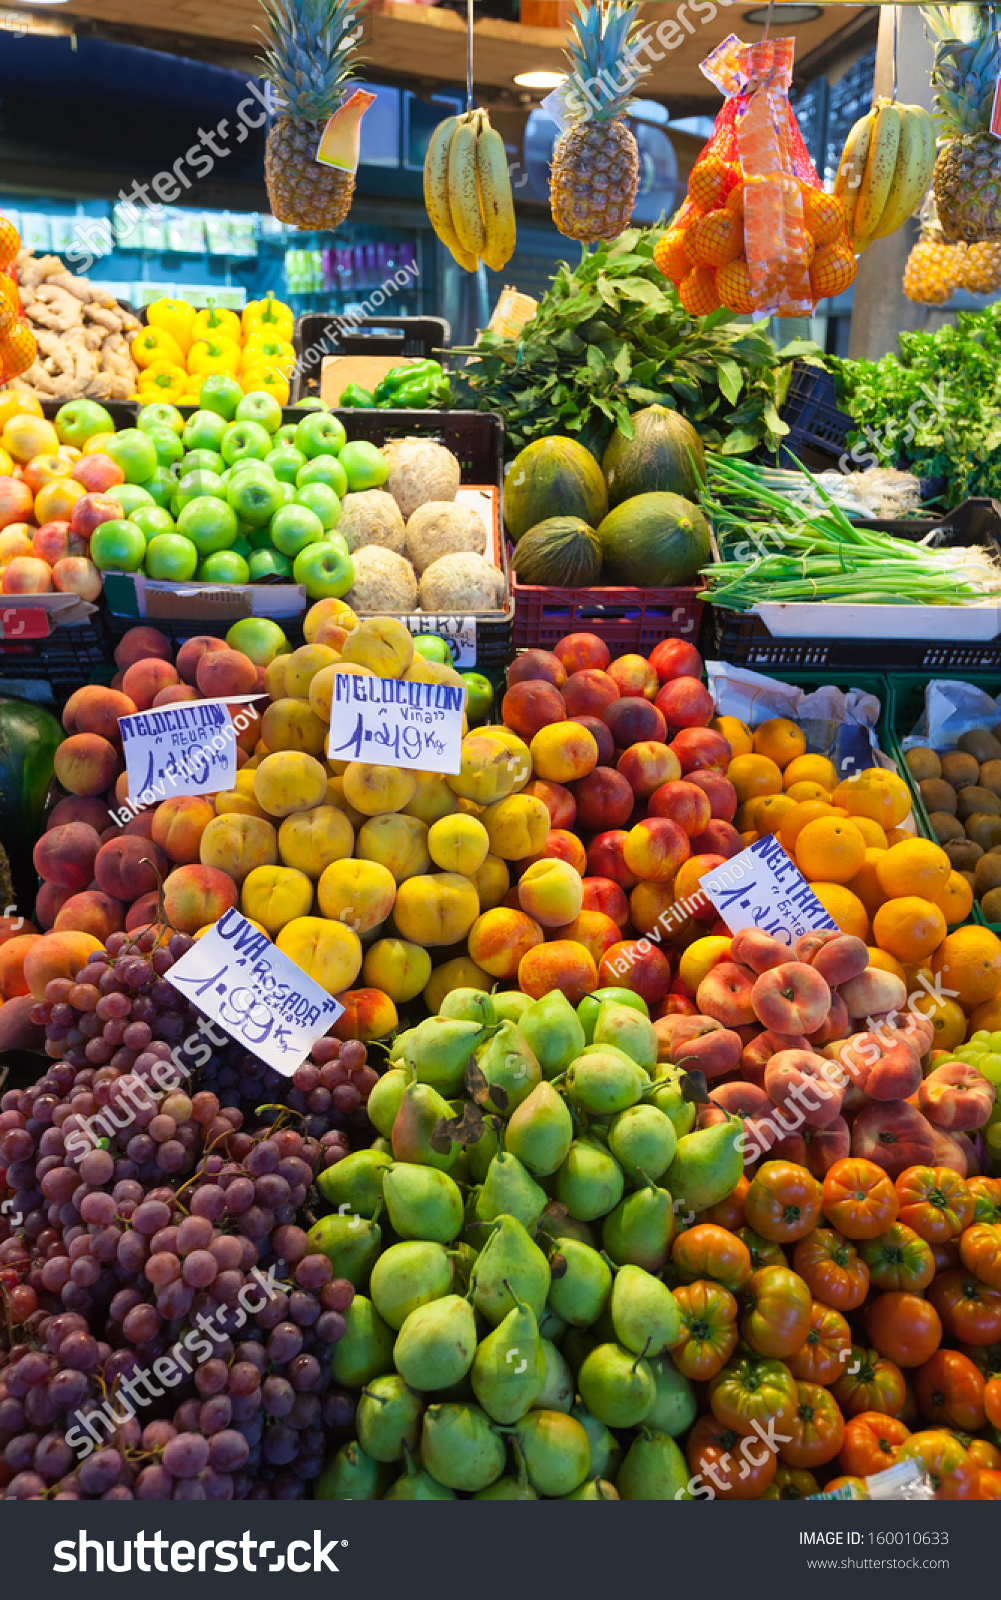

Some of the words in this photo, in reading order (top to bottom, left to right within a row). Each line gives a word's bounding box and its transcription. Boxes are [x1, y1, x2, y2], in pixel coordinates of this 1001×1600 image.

[336, 673, 462, 711] MELOCOTON
[120, 703, 225, 741] MELOCOTON
[424, 731, 447, 755] Kg
[216, 908, 271, 961] UVA
